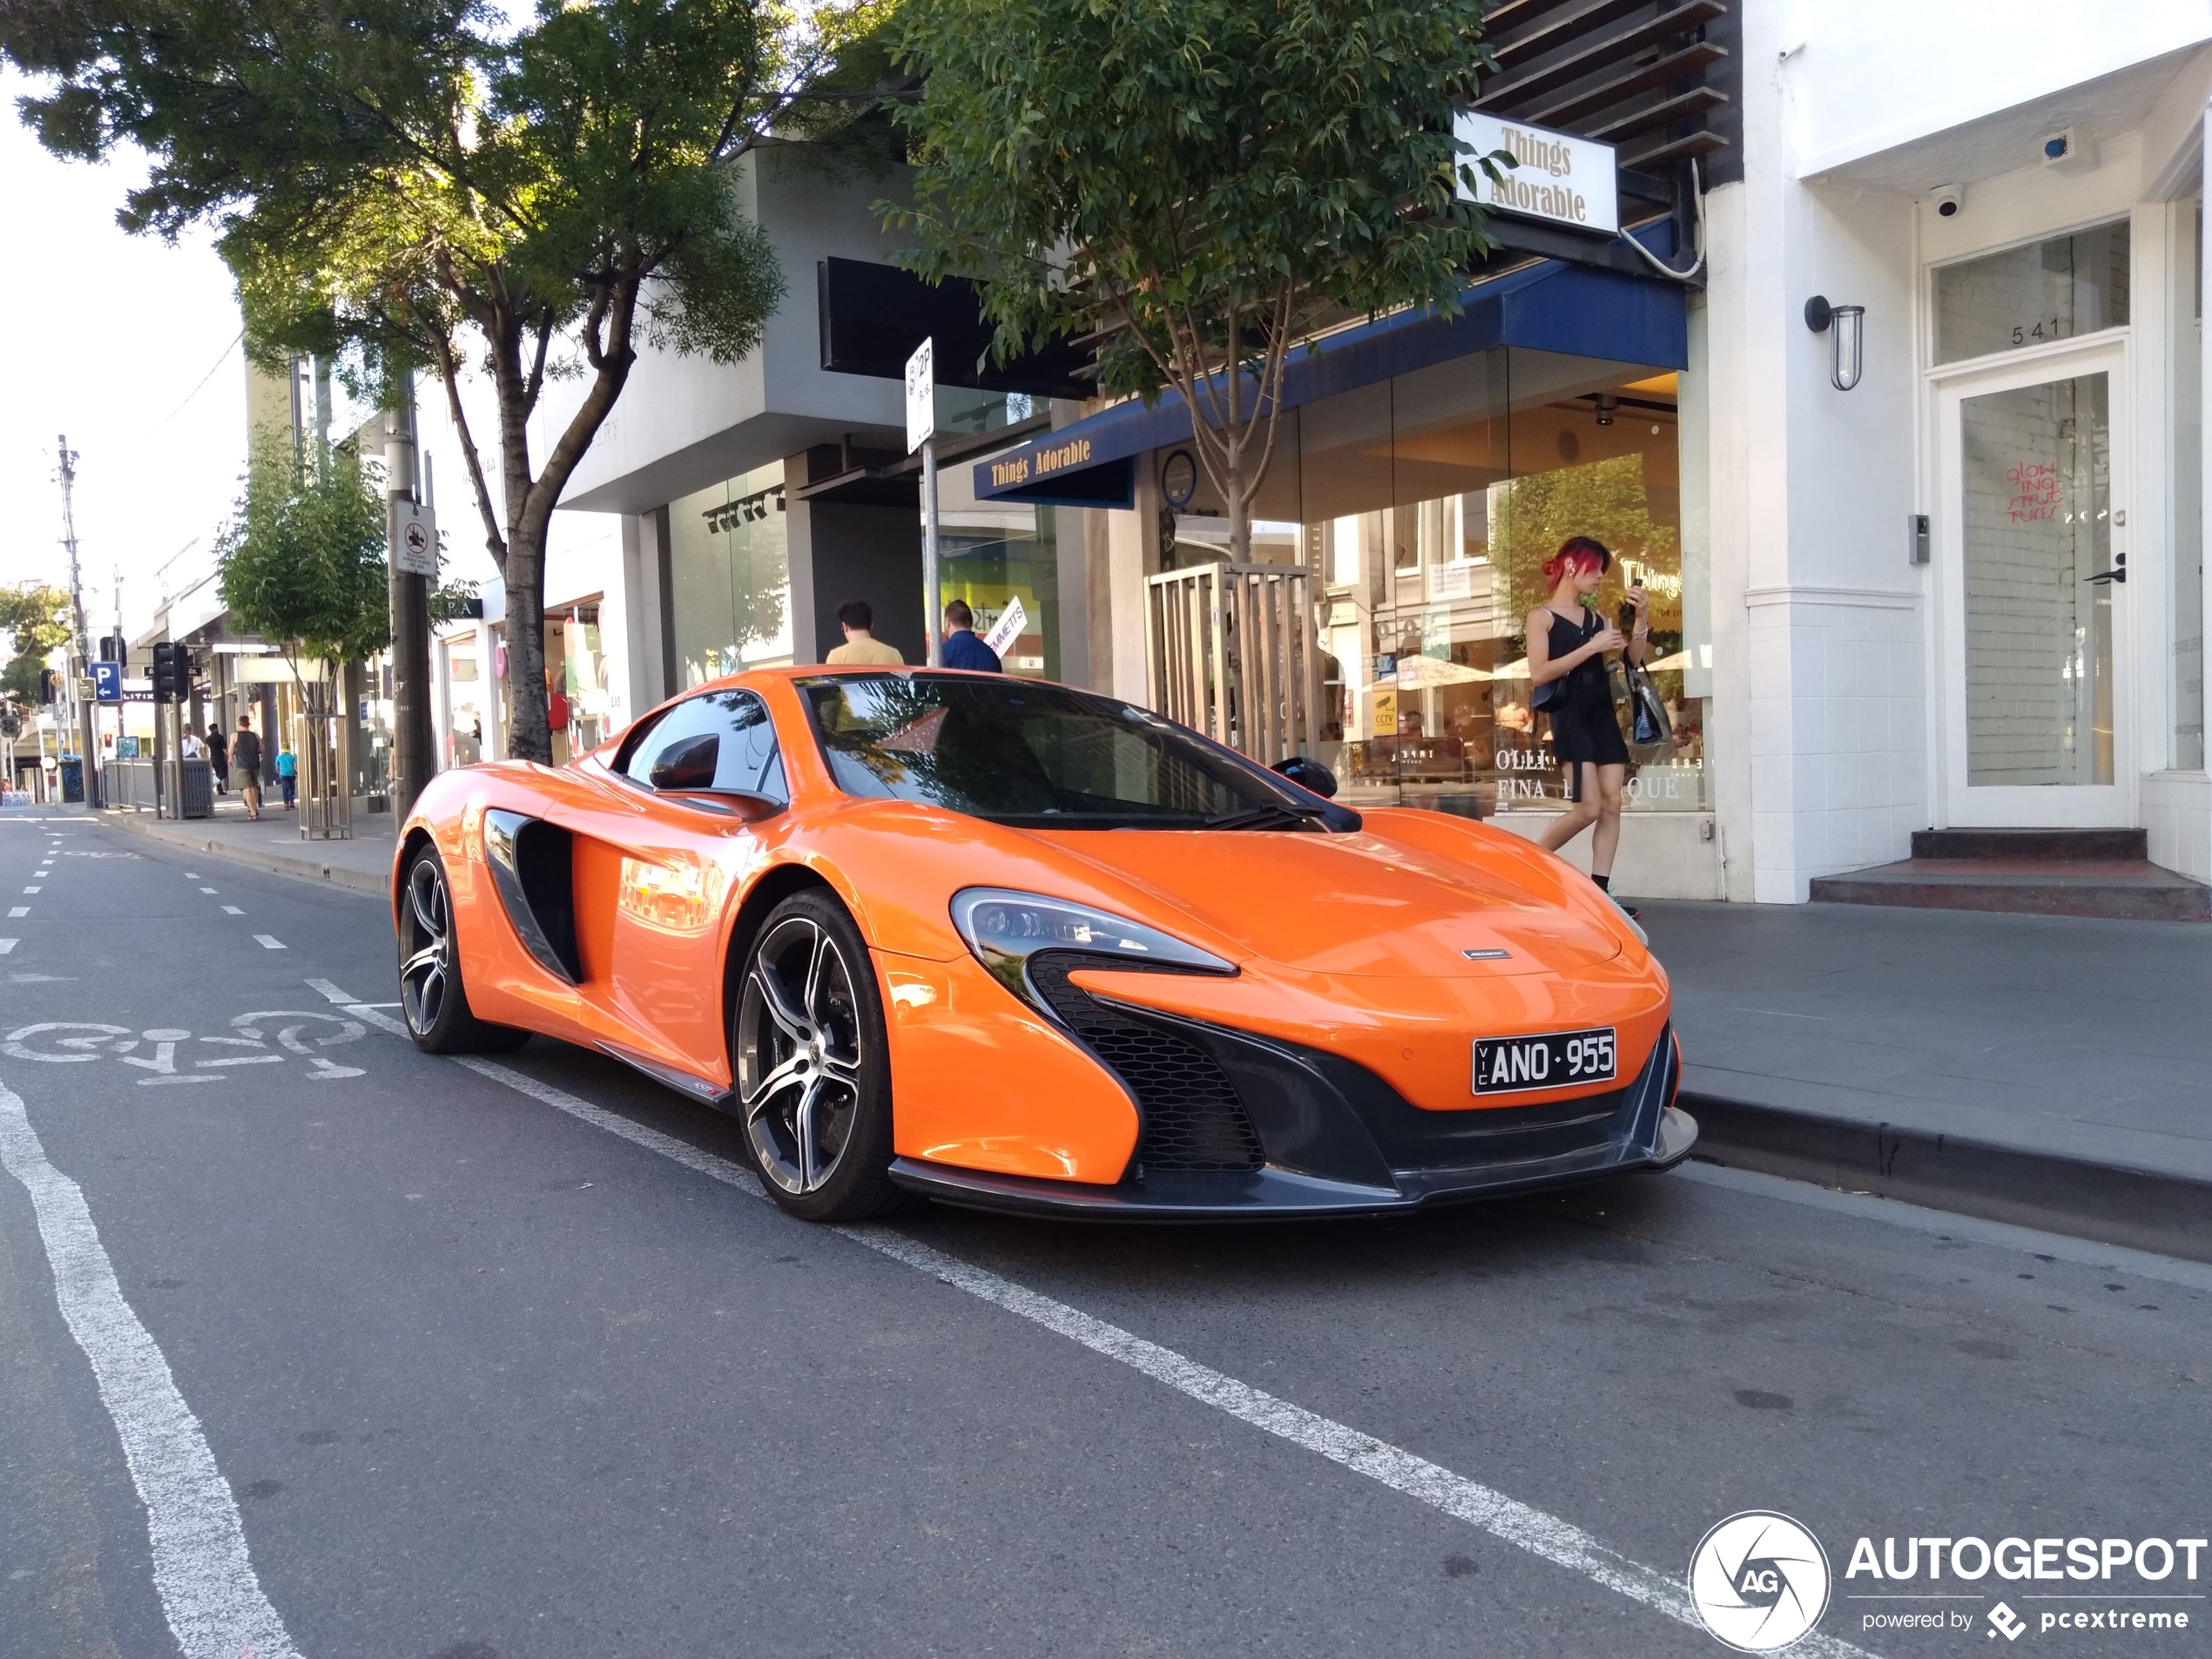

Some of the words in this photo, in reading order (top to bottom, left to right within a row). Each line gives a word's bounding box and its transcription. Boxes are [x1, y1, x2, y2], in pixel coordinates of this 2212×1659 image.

[1501, 126, 1571, 178] Things
[1491, 174, 1586, 222] Adorable
[2013, 318, 2058, 345] 541
[918, 347, 931, 378] 2P
[992, 458, 1028, 487] Things
[1035, 440, 1090, 475] Adorable
[97, 667, 111, 685] P
[1375, 714, 1393, 724] CCTV
[1498, 779, 1547, 800] FINA
[1478, 1047, 1488, 1085] VIC
[1491, 1043, 1548, 1084] ANO
[1567, 1036, 1614, 1076] 955
